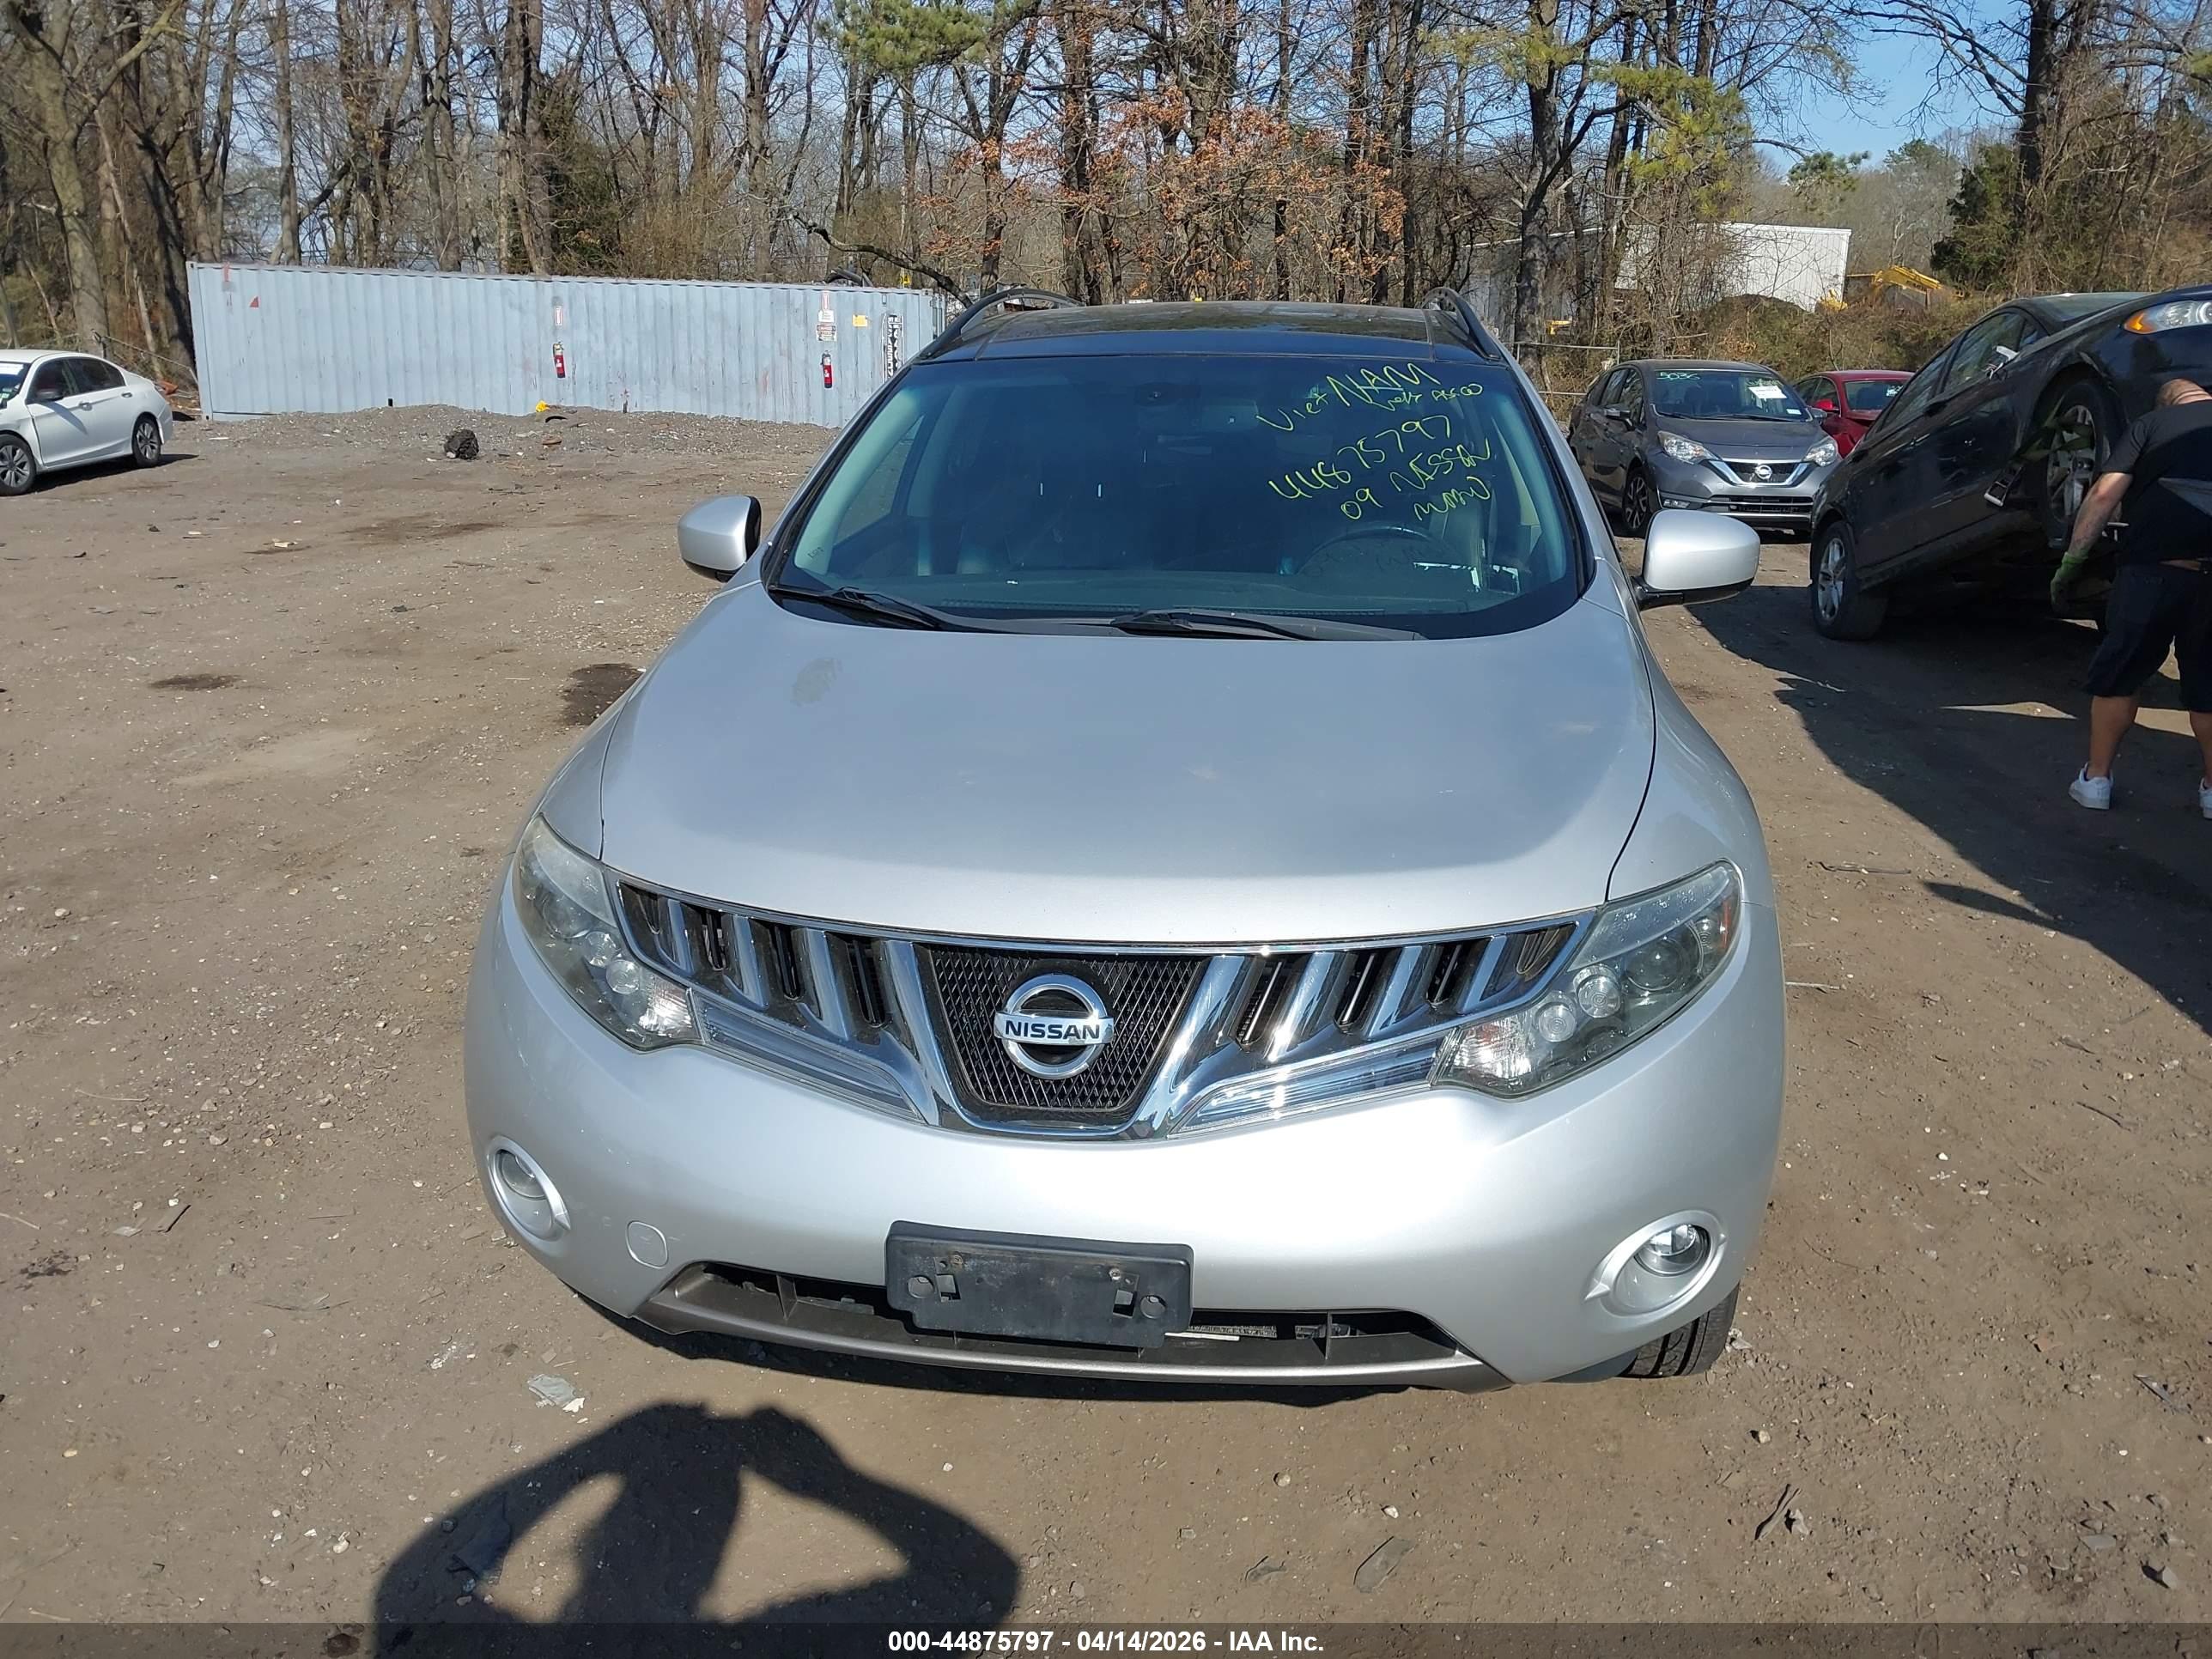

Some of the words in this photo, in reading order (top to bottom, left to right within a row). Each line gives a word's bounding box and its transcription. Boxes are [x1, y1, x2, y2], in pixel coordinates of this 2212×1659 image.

[1267, 415, 1451, 499] 44875797
[1340, 487, 1384, 520] 09
[1005, 1019, 1100, 1040] NISSAN
